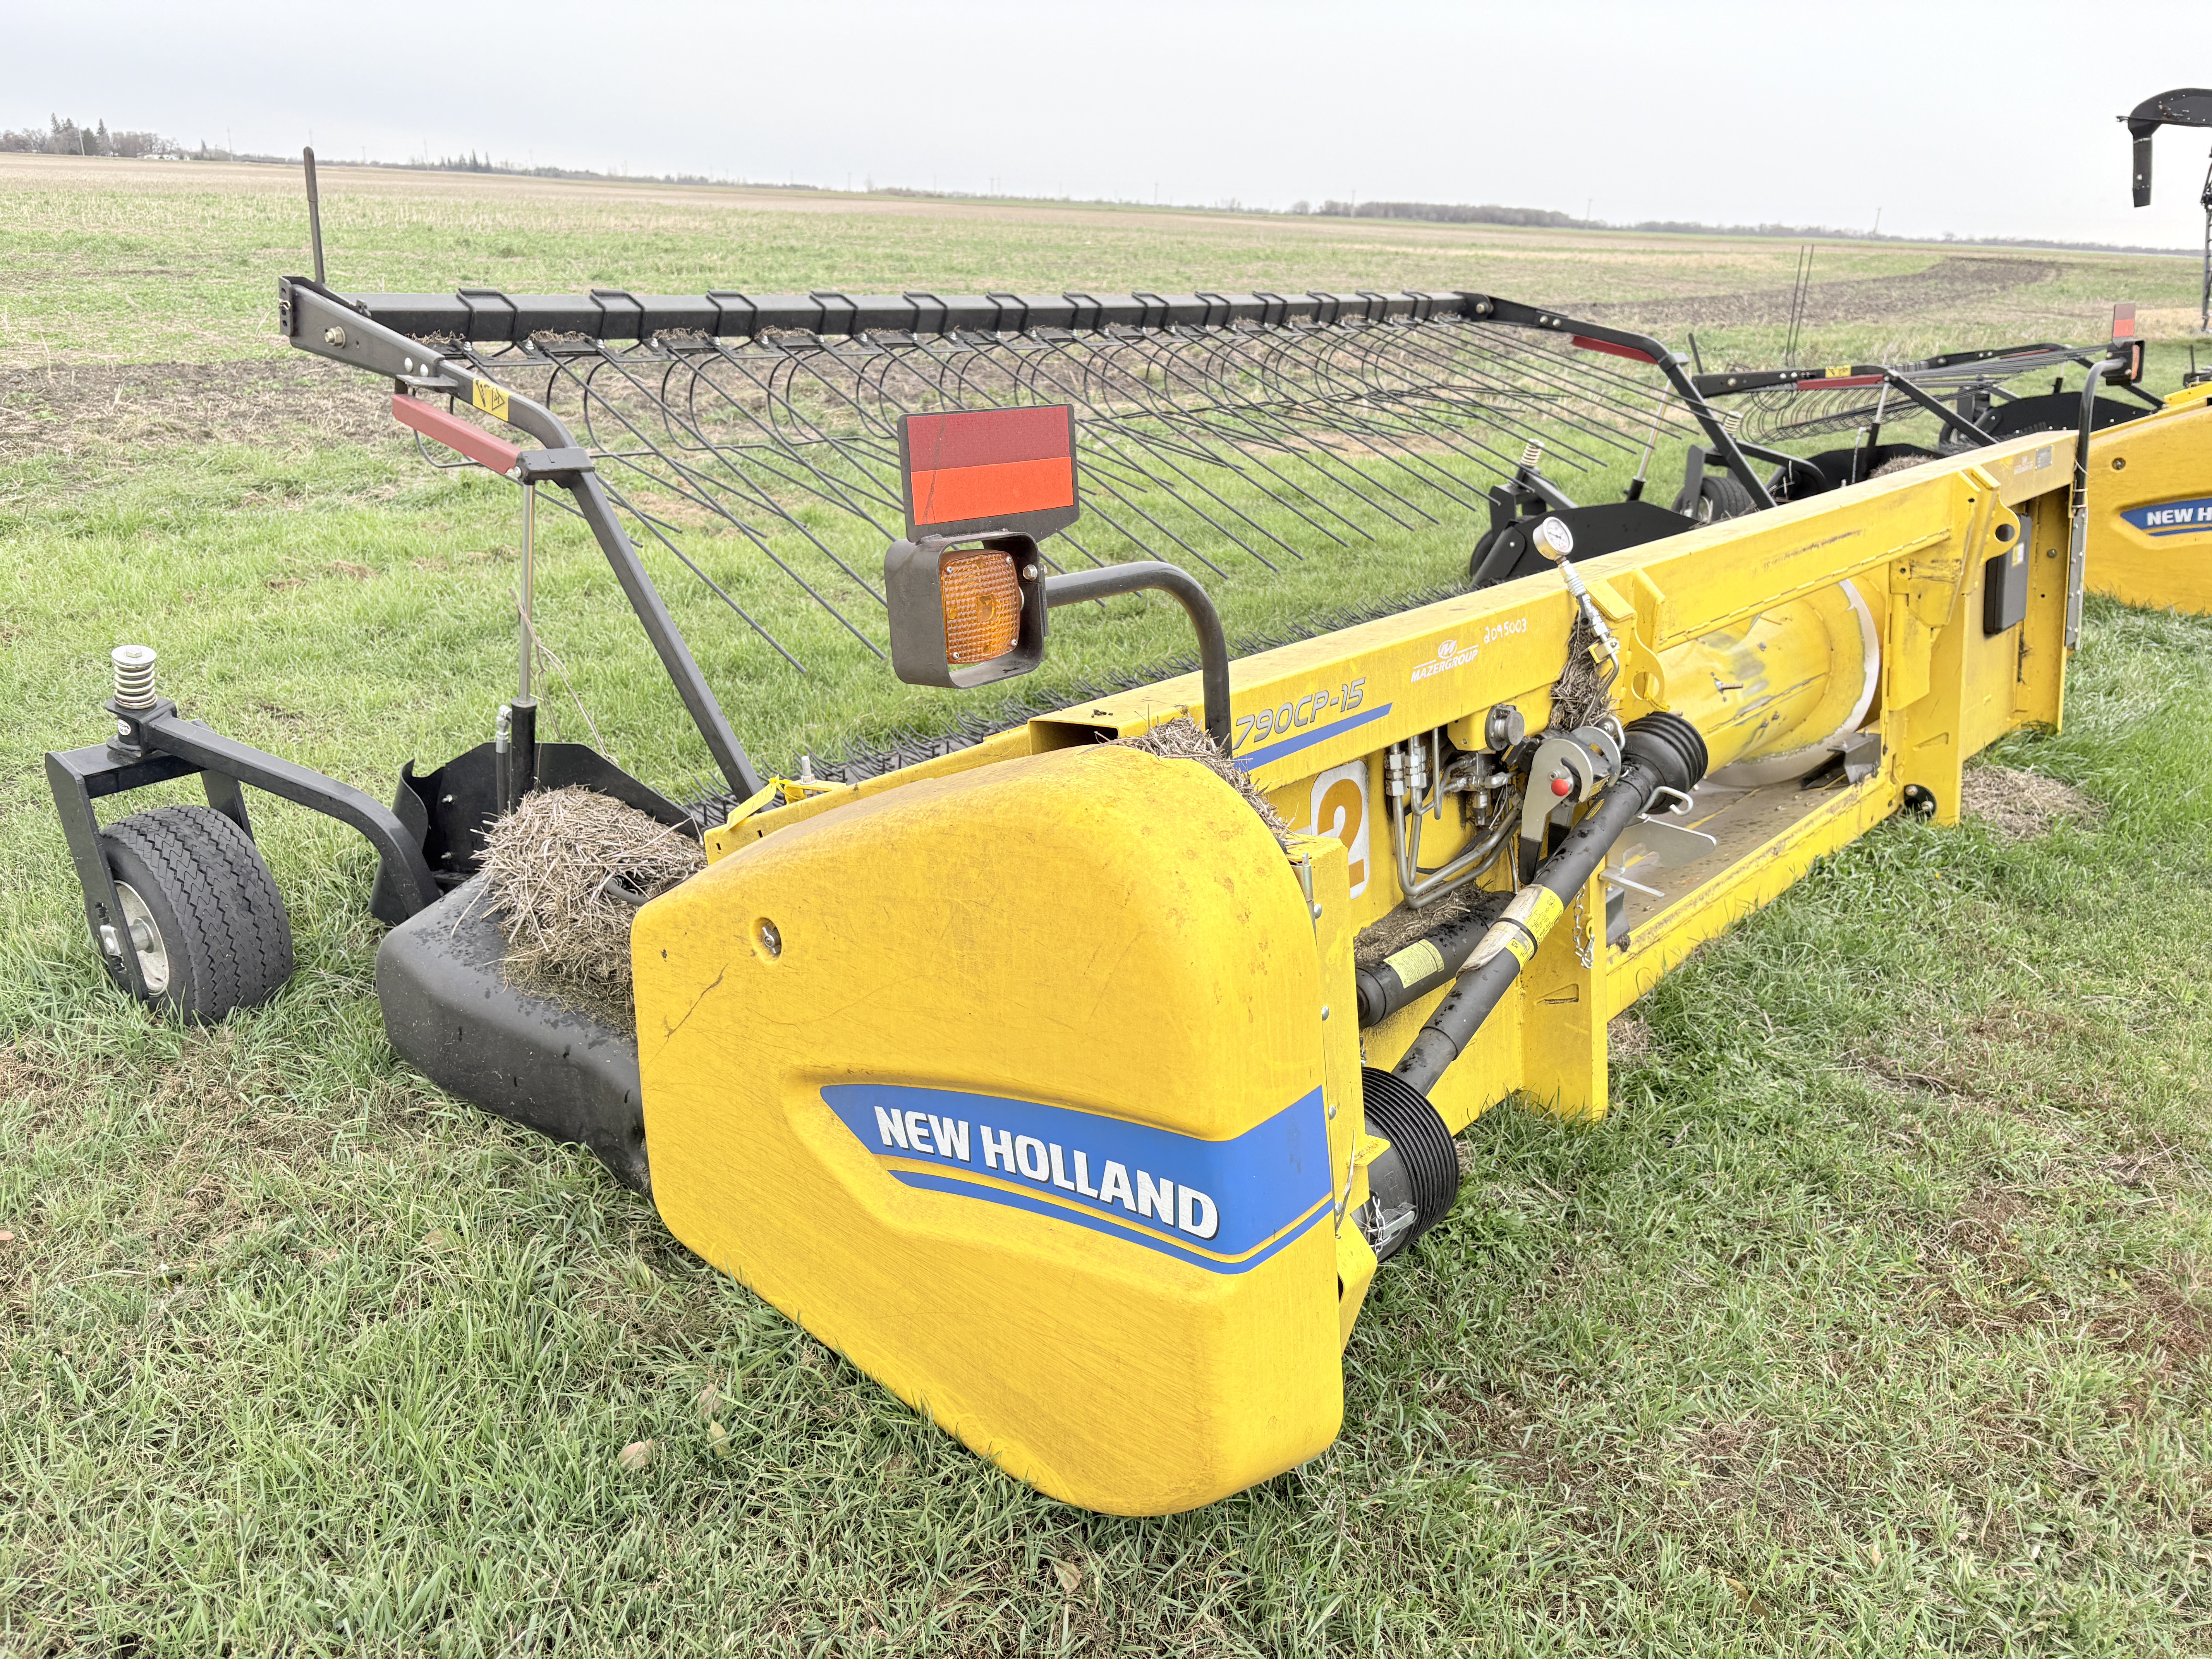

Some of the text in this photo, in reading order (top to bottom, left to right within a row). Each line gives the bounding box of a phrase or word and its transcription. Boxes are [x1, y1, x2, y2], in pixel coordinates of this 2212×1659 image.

[2147, 508, 2193, 526] NEW
[1484, 618, 1527, 643] 2095003
[1411, 649, 1478, 683] MAZERGROUP
[1232, 677, 1366, 750] 790CP-15
[874, 1106, 1220, 1241] NEW HOLLAND
